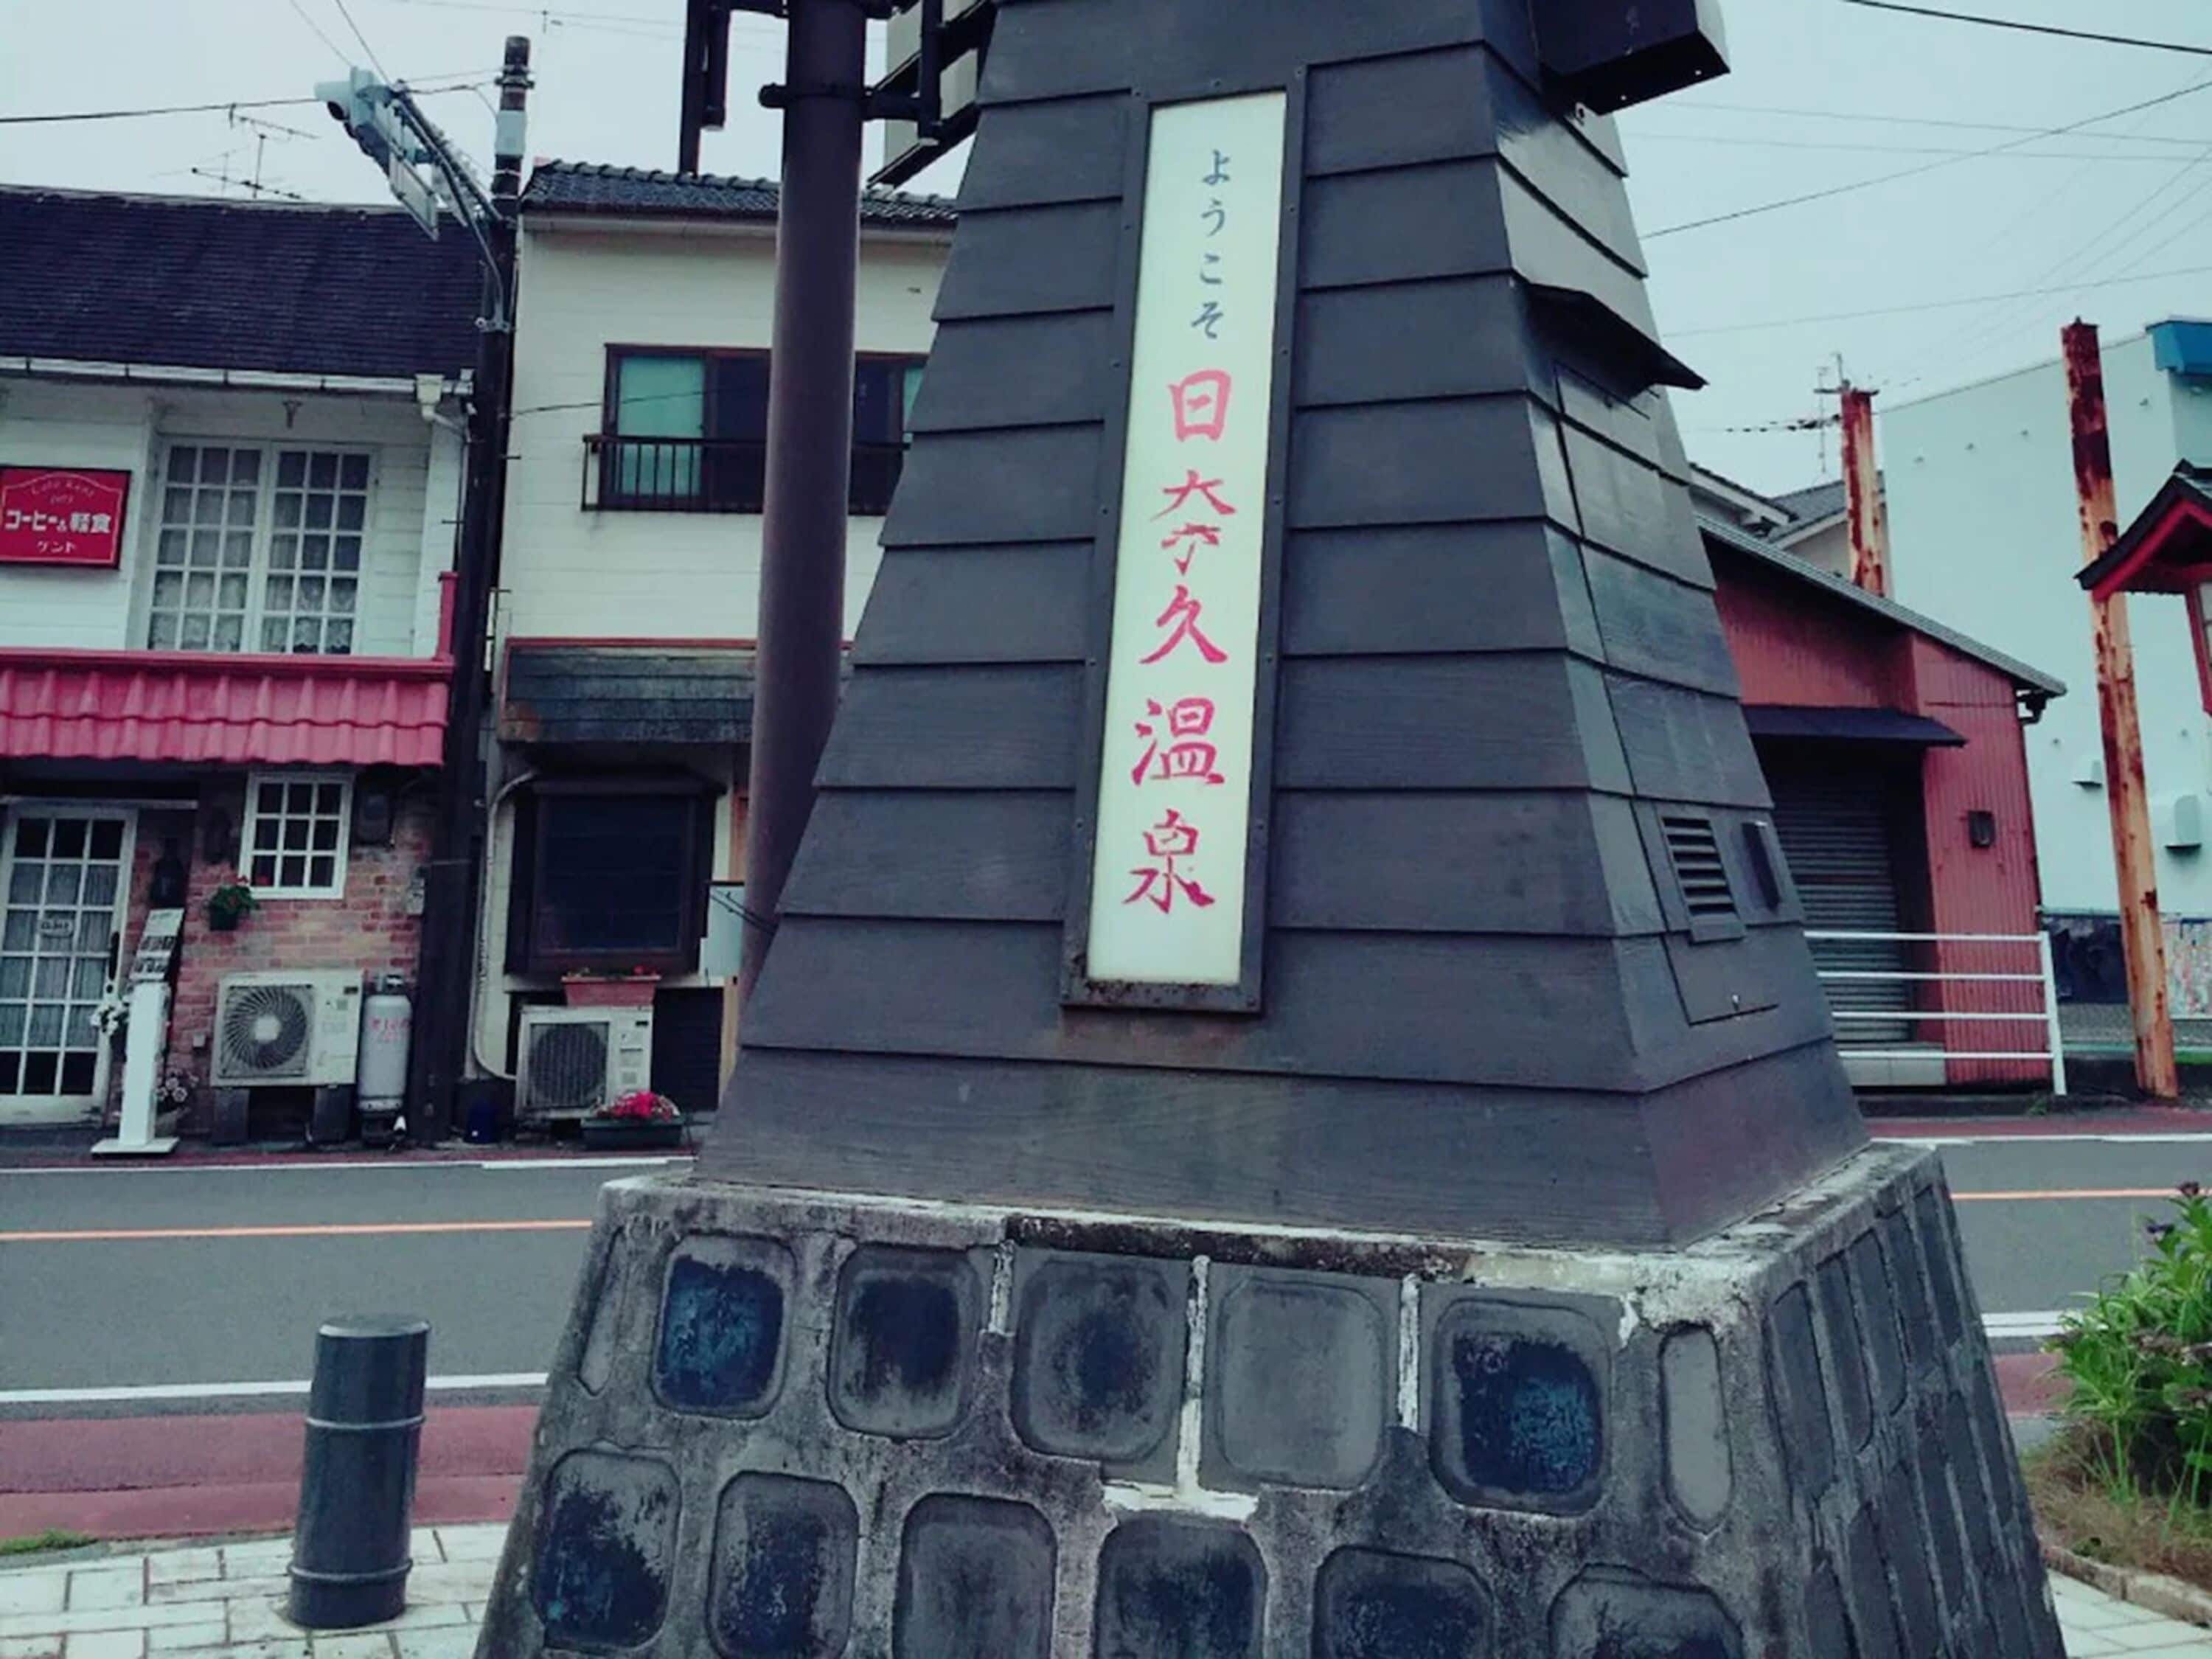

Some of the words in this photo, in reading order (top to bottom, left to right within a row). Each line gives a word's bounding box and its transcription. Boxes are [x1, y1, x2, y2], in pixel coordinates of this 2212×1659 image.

[1191, 150, 1231, 339] ようこそ
[1122, 369, 1237, 914] 日奈久温泉
